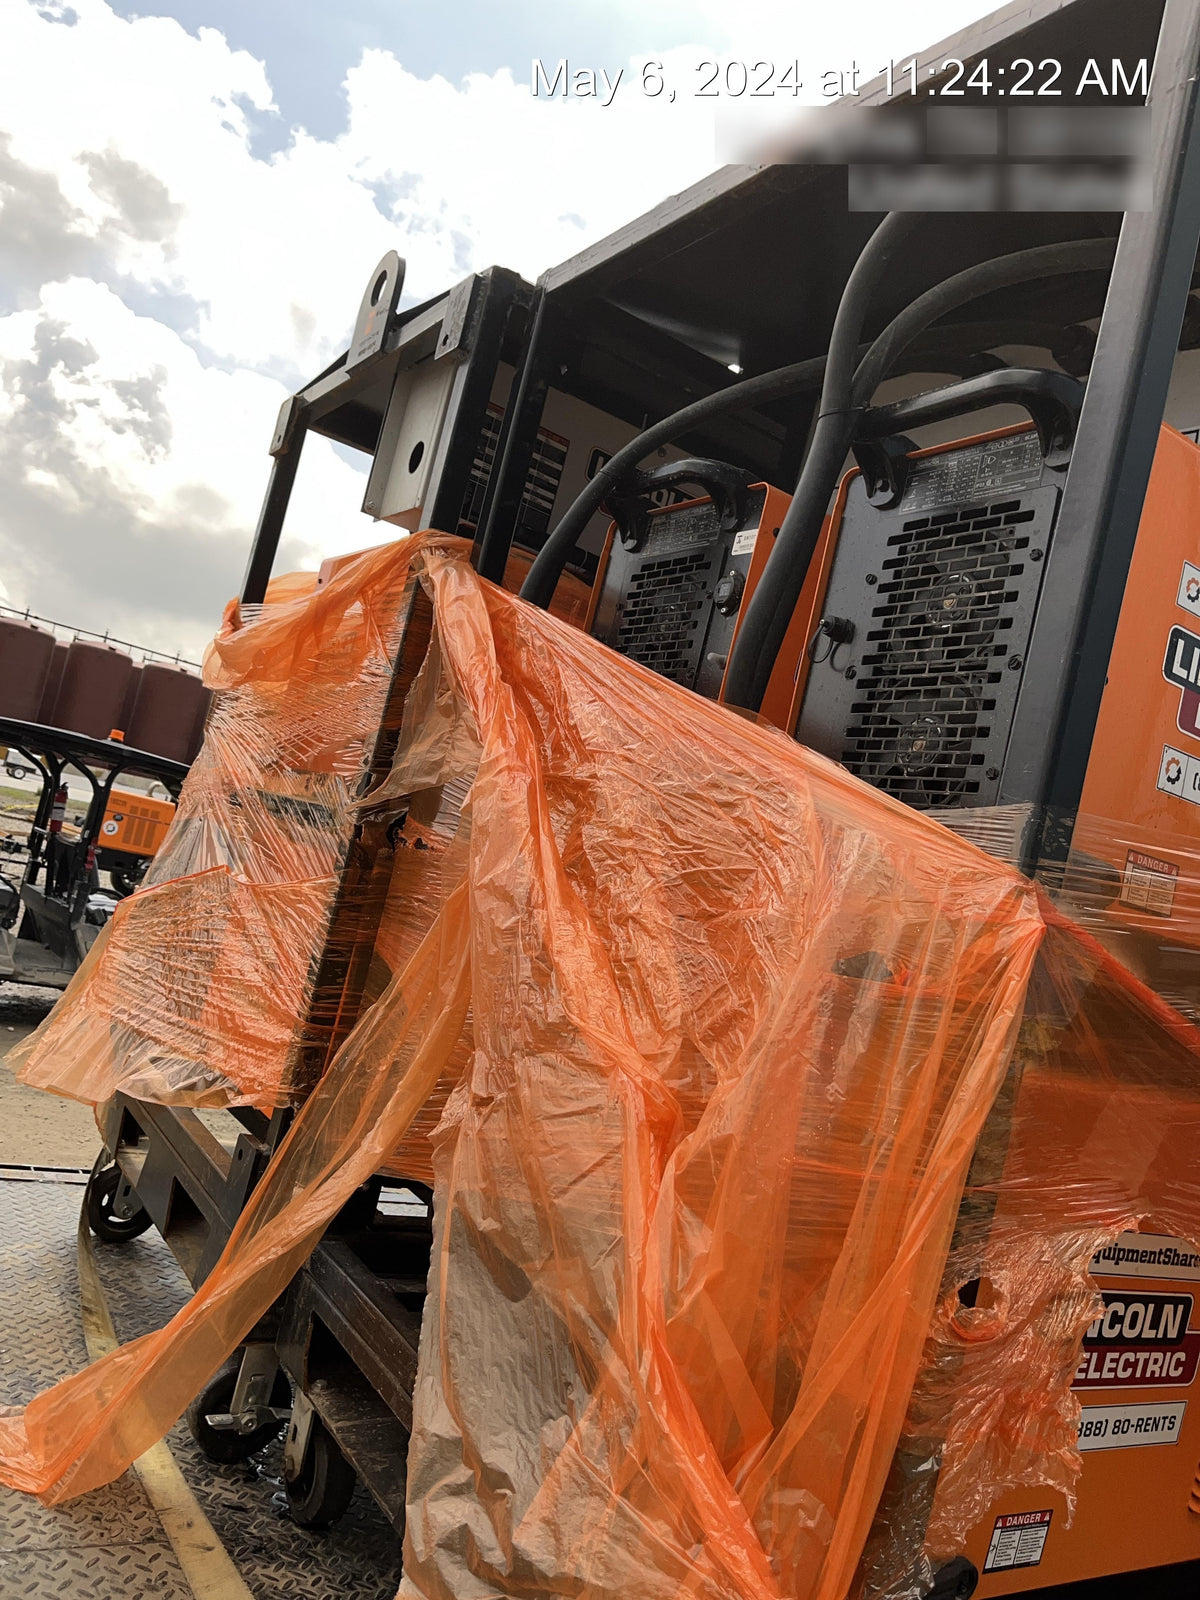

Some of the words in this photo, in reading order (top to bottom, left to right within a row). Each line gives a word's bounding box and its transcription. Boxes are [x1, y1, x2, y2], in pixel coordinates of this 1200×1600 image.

[1172, 638, 1200, 687] LI
[1137, 855, 1169, 873] DANGER
[1074, 1352, 1186, 1379] ELECTRIC
[1112, 1415, 1177, 1435] 80-RENTS
[1006, 1513, 1042, 1526] DANGER
